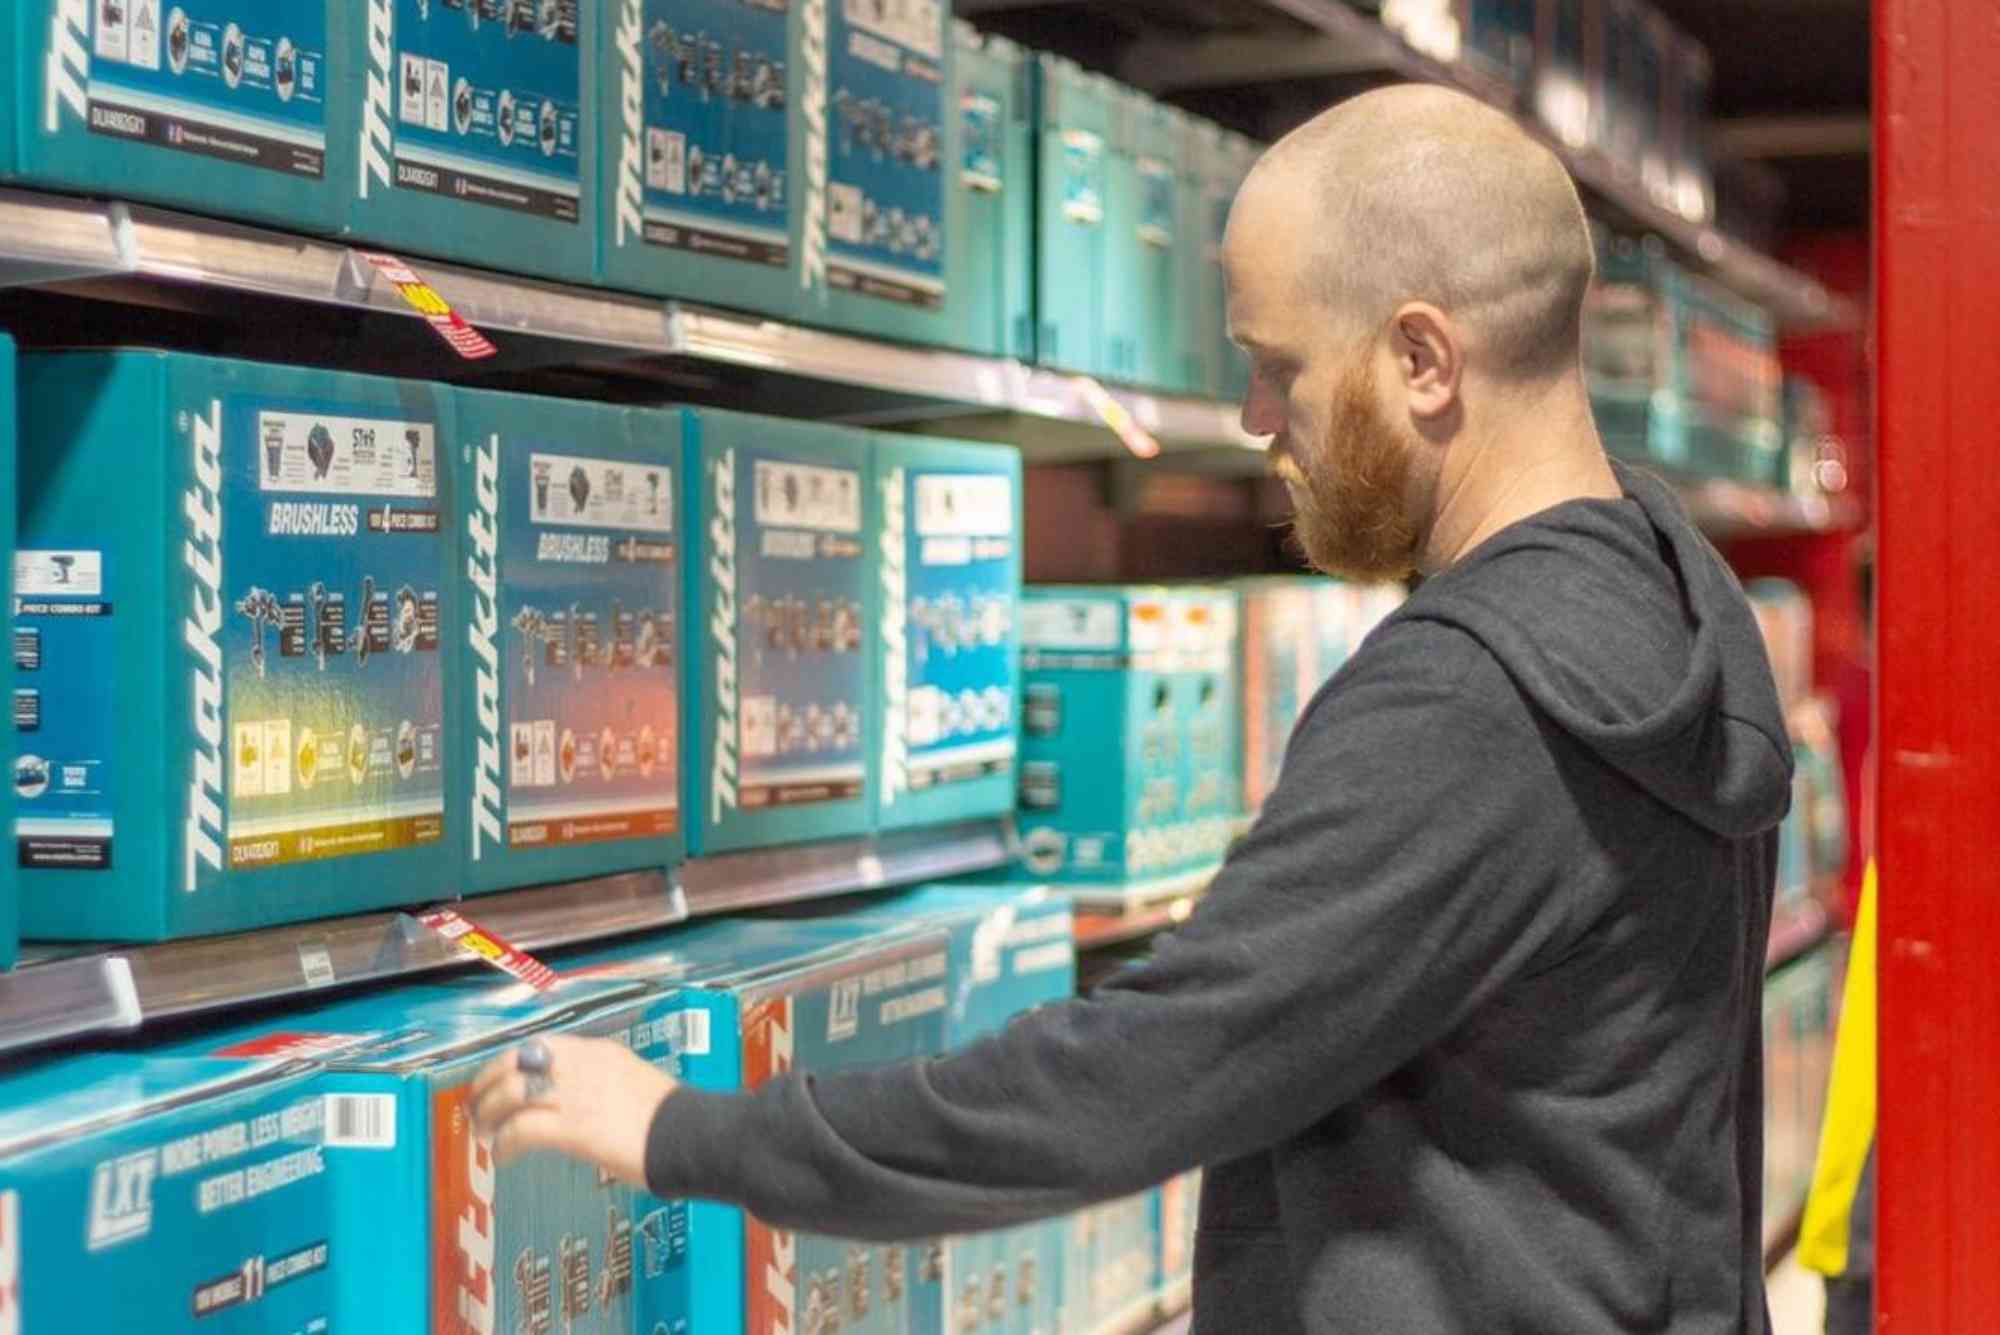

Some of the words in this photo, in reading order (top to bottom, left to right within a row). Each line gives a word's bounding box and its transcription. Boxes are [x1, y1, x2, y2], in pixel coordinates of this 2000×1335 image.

[186, 399, 223, 893] makita
[269, 502, 360, 535] BRUSHLESS
[466, 433, 500, 861] makita
[711, 446, 738, 824] makita
[88, 1147, 158, 1250] LXT
